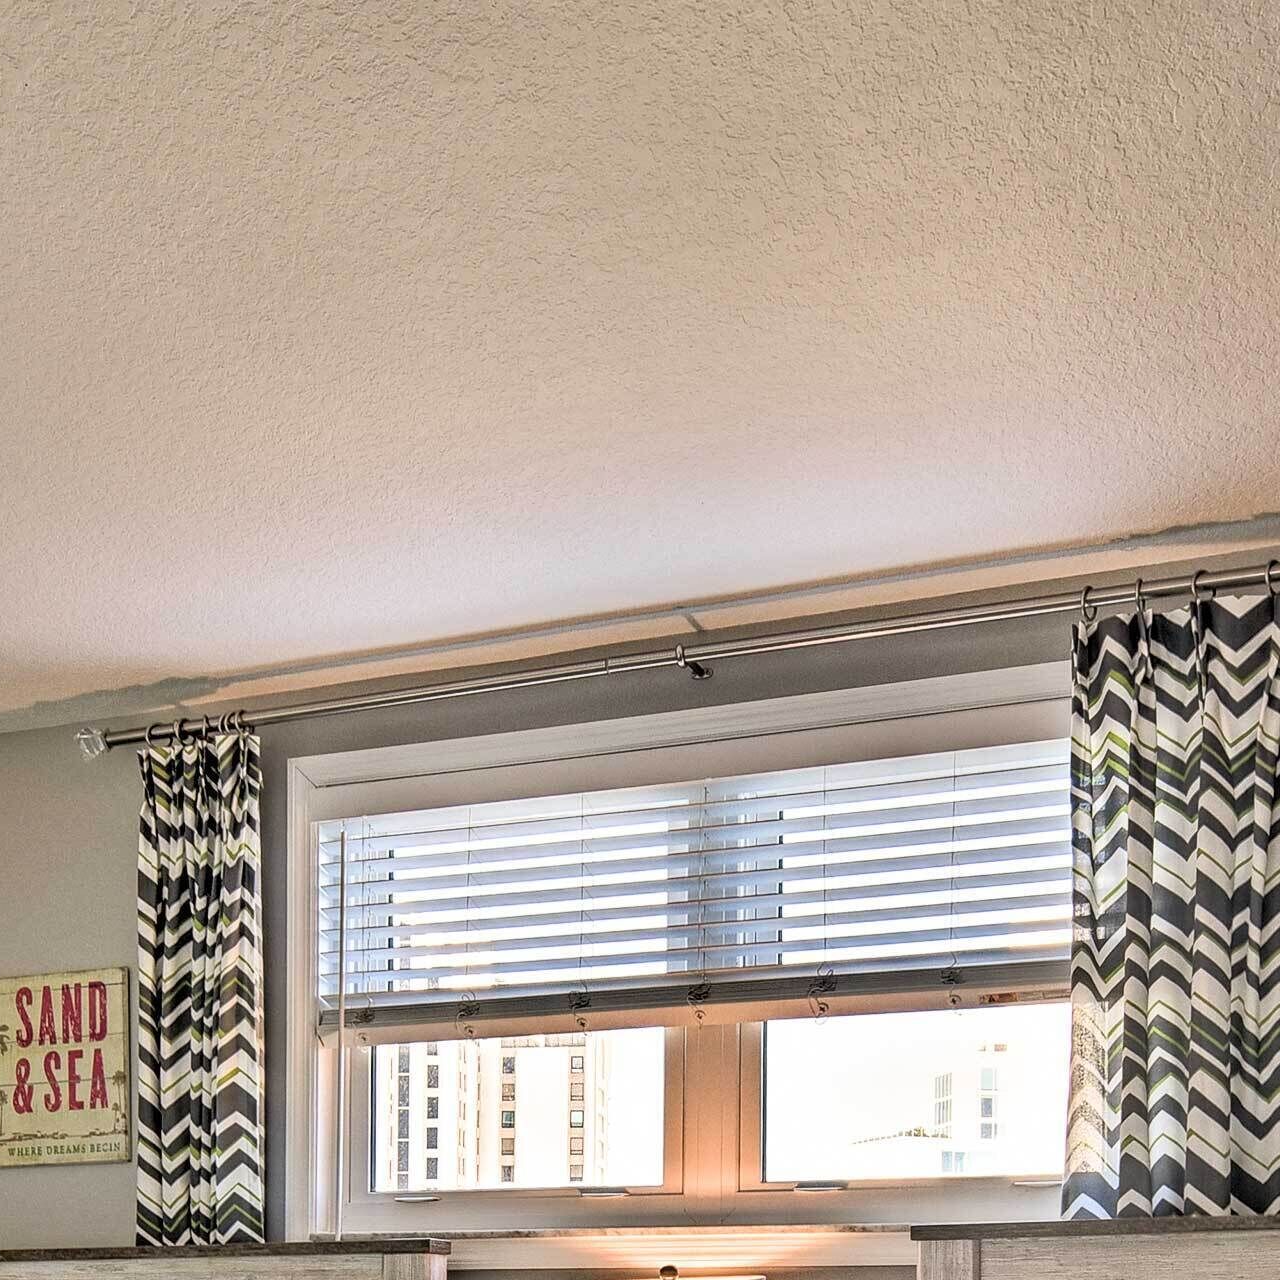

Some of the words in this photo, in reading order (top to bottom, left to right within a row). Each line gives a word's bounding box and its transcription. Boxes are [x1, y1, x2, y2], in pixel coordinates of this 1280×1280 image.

[15, 981, 108, 1048] SAND
[12, 1057, 34, 1115] &
[43, 1048, 109, 1113] SEA
[7, 1146, 43, 1157] WHERE
[46, 1144, 86, 1155] DREAMS
[89, 1142, 121, 1153] BEGIN
